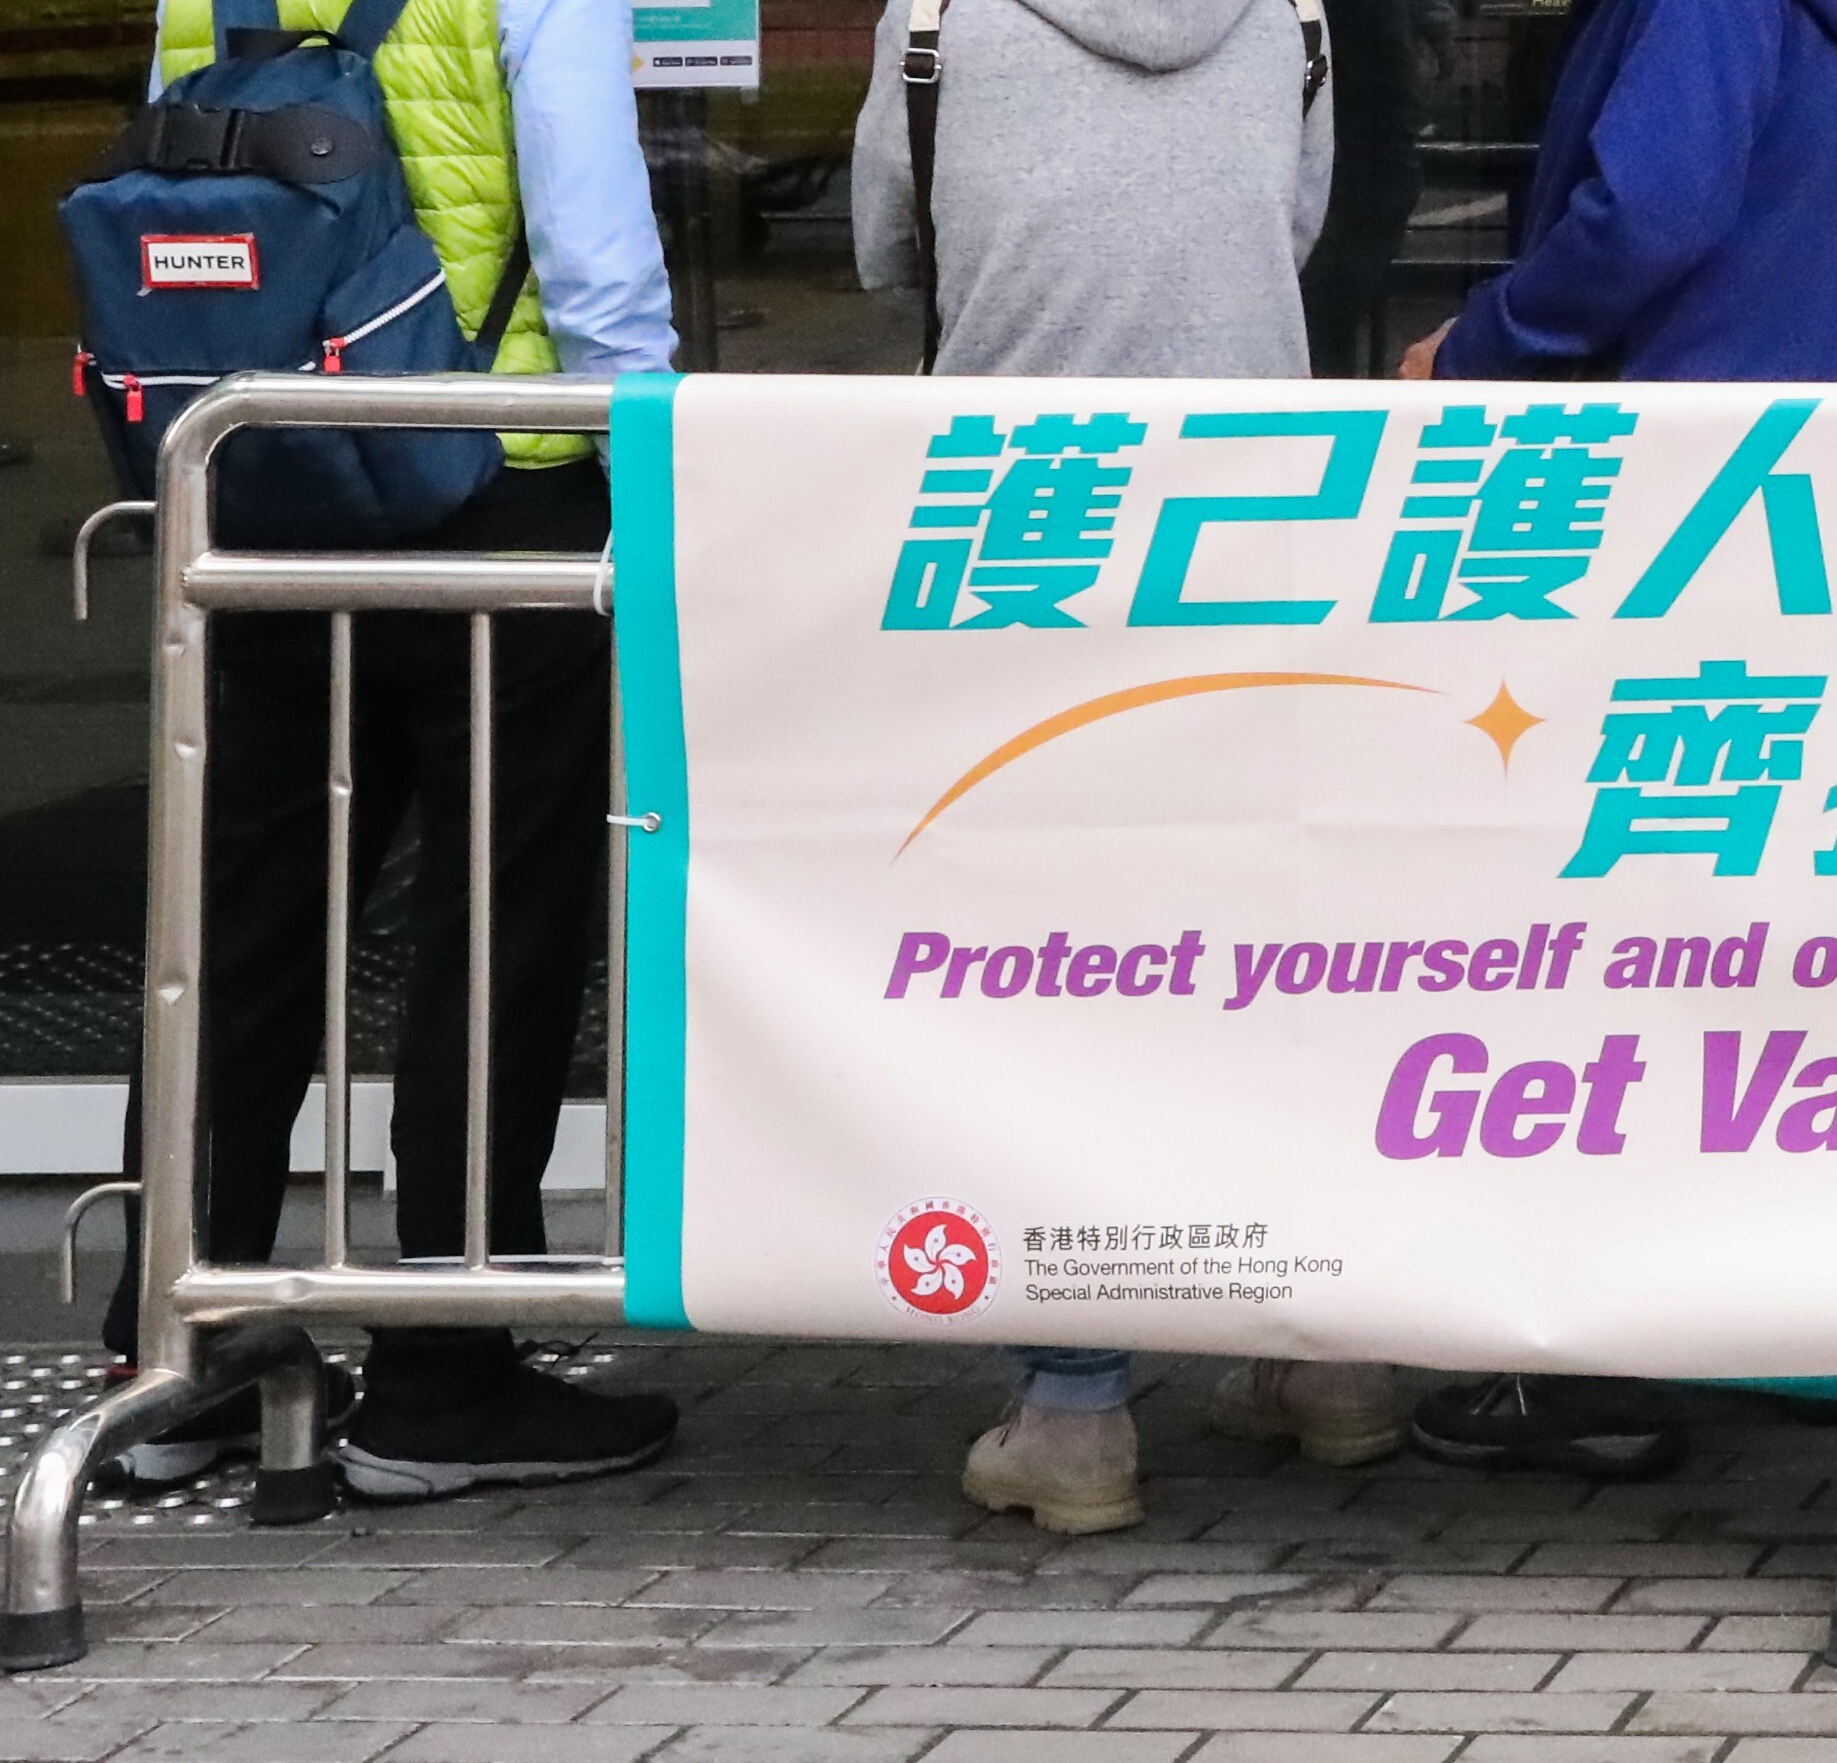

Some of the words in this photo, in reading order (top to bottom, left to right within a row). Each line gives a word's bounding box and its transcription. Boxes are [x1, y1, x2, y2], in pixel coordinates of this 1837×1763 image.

[154, 255, 245, 269] HUNTER
[880, 400, 1832, 631] 護己護人
[883, 929, 1206, 999] Protect
[1222, 921, 1588, 1011] yourself
[1603, 921, 1770, 990] and
[1375, 1032, 1647, 1161] Get
[1022, 1222, 1268, 1252] 香港特別行政區政府
[1023, 1259, 1059, 1277] The
[1063, 1258, 1175, 1277] Government
[1179, 1257, 1198, 1275] of
[1202, 1257, 1232, 1275] the
[1238, 1256, 1288, 1278] Hong
[1294, 1256, 1343, 1277] Kong
[1025, 1283, 1092, 1304] Special
[1096, 1283, 1224, 1301] Administrative
[1229, 1282, 1293, 1304] Region
